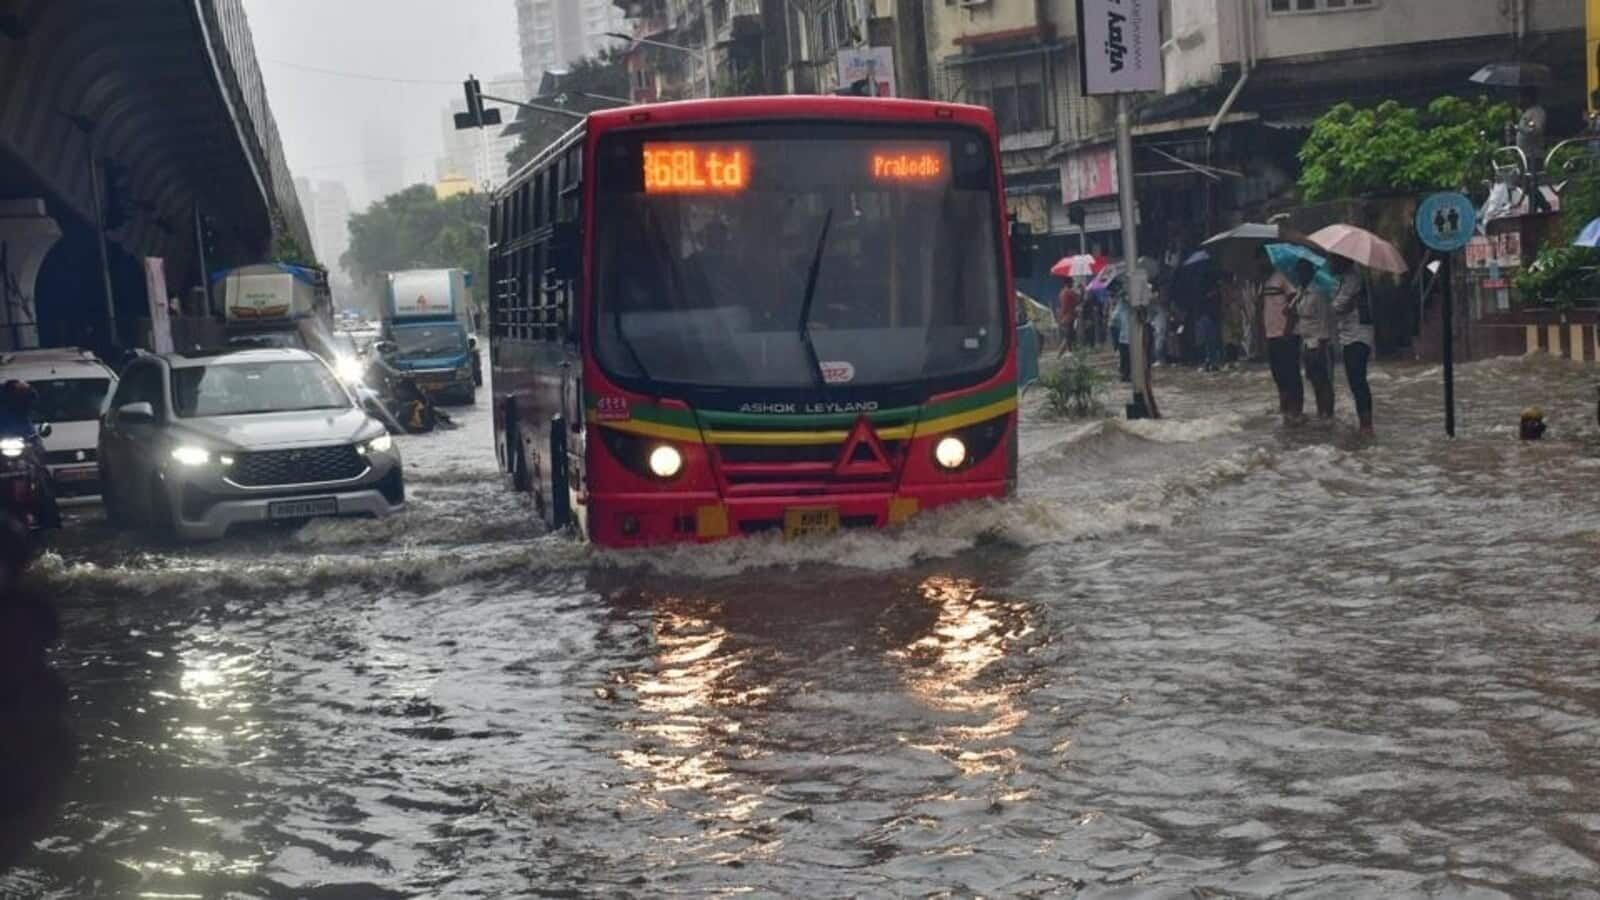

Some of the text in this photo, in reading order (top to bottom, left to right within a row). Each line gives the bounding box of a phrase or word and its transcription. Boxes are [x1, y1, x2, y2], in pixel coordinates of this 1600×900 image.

[1104, 11, 1127, 73] vijay
[739, 401, 878, 413] ASHOK LEYLAND
